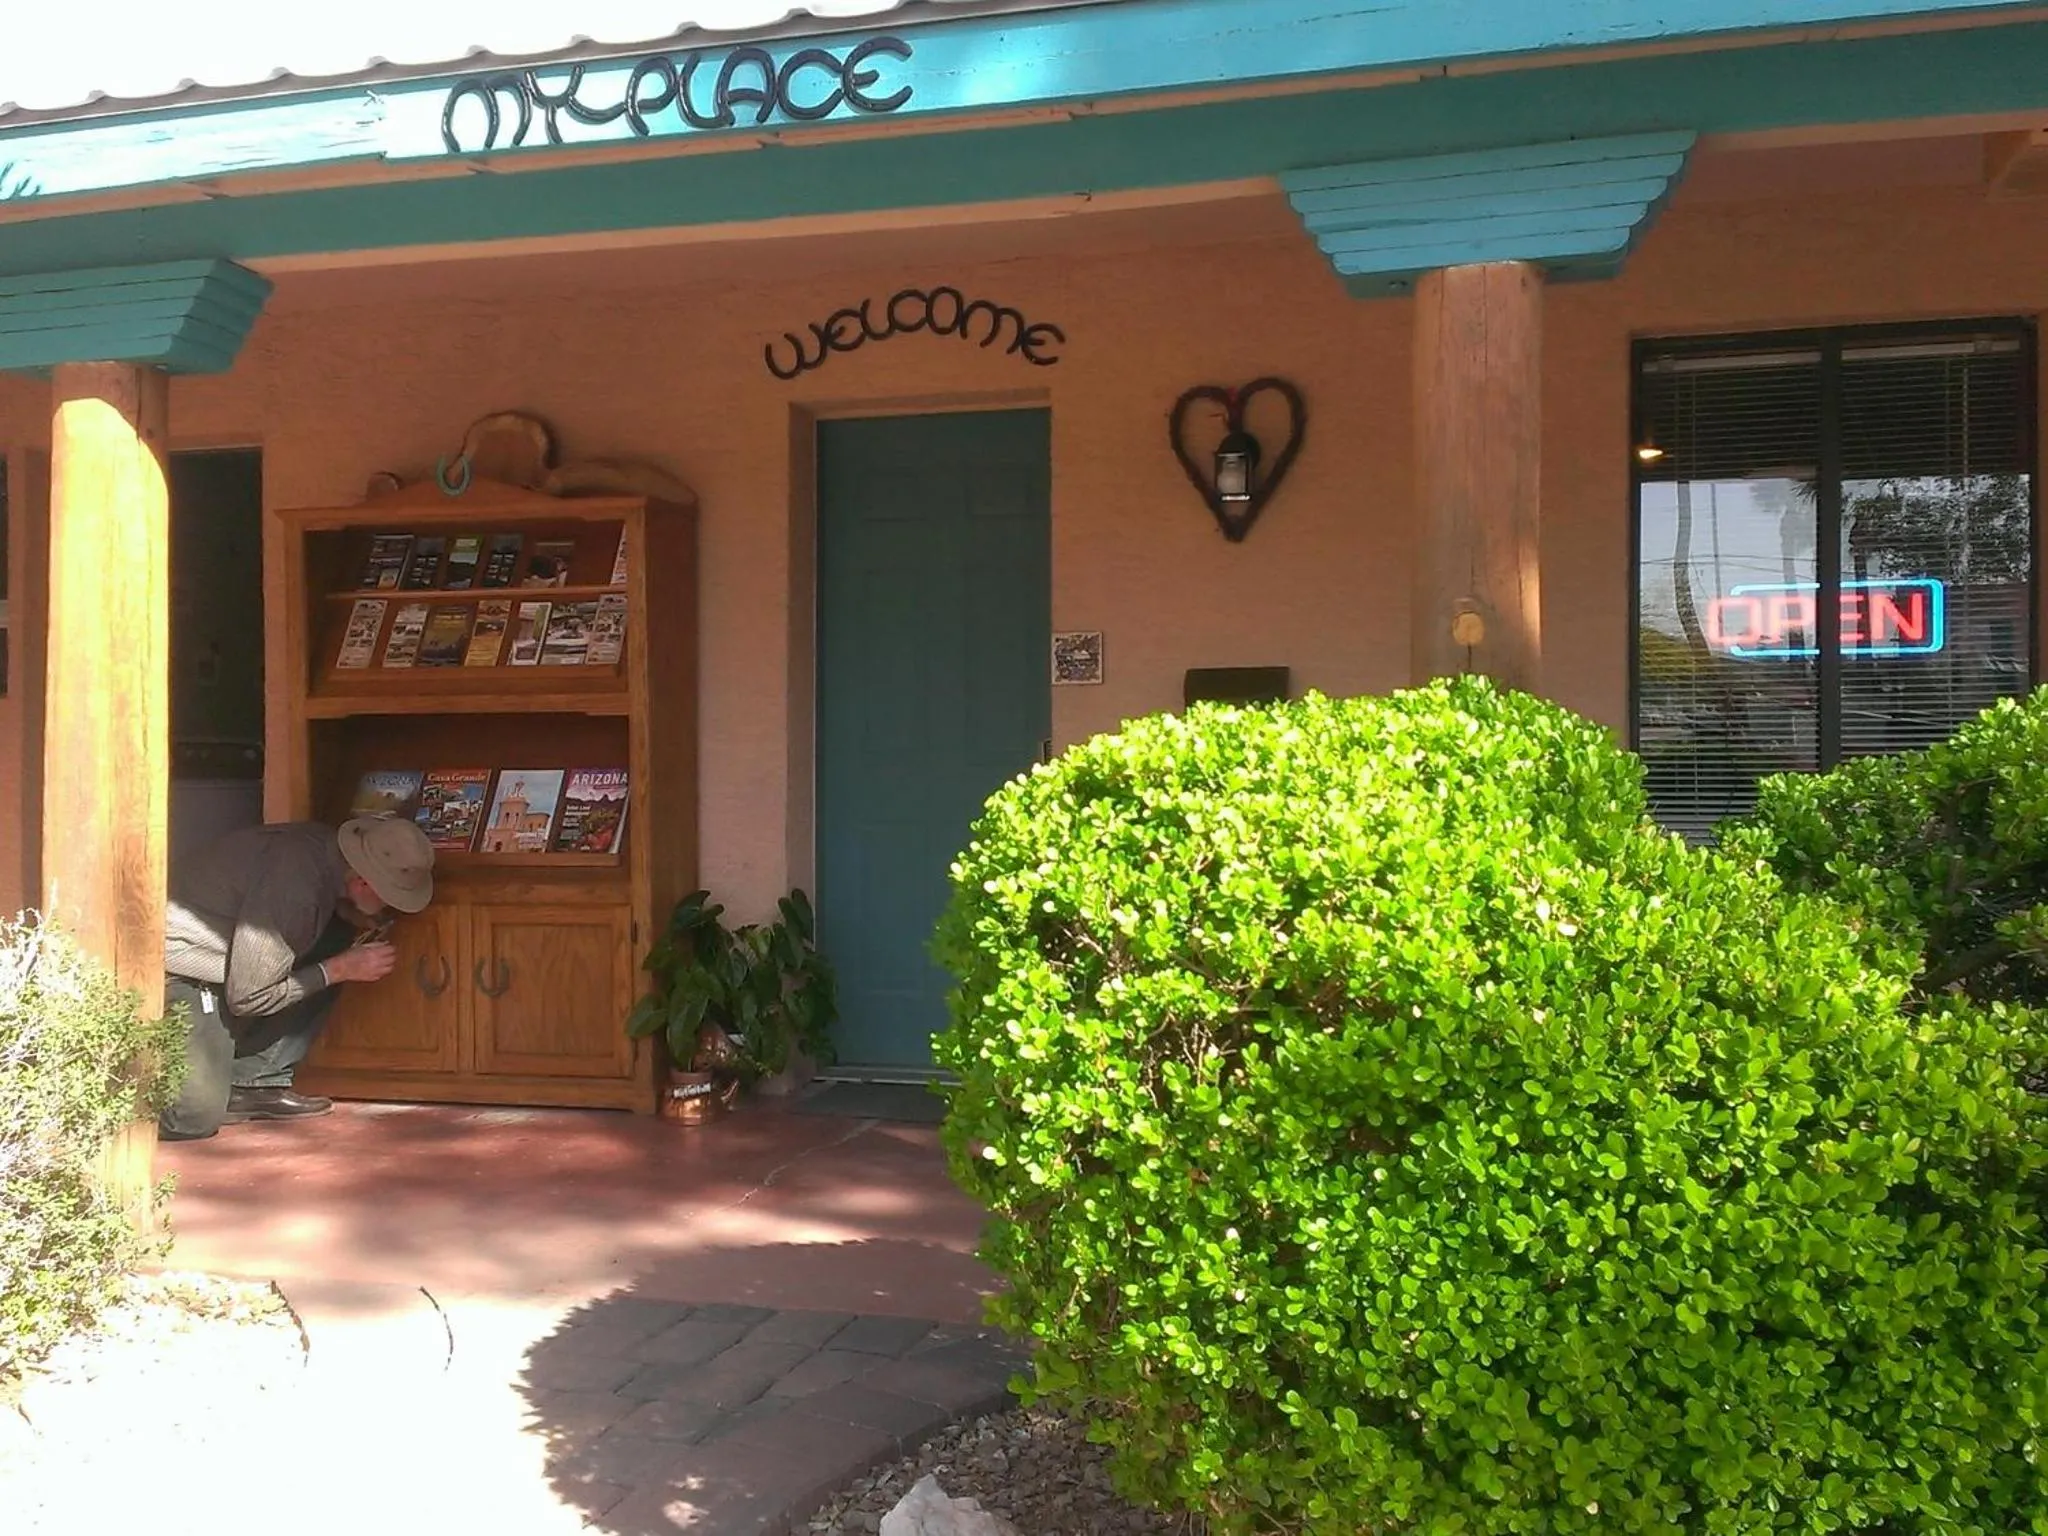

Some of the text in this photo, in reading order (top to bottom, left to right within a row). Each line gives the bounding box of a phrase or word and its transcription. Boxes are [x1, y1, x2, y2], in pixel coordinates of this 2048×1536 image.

[625, 36, 914, 137] PLACE
[765, 287, 1066, 379] WELCOME
[1707, 592, 1924, 645] OPEN
[571, 772, 628, 785] ARIZONA
